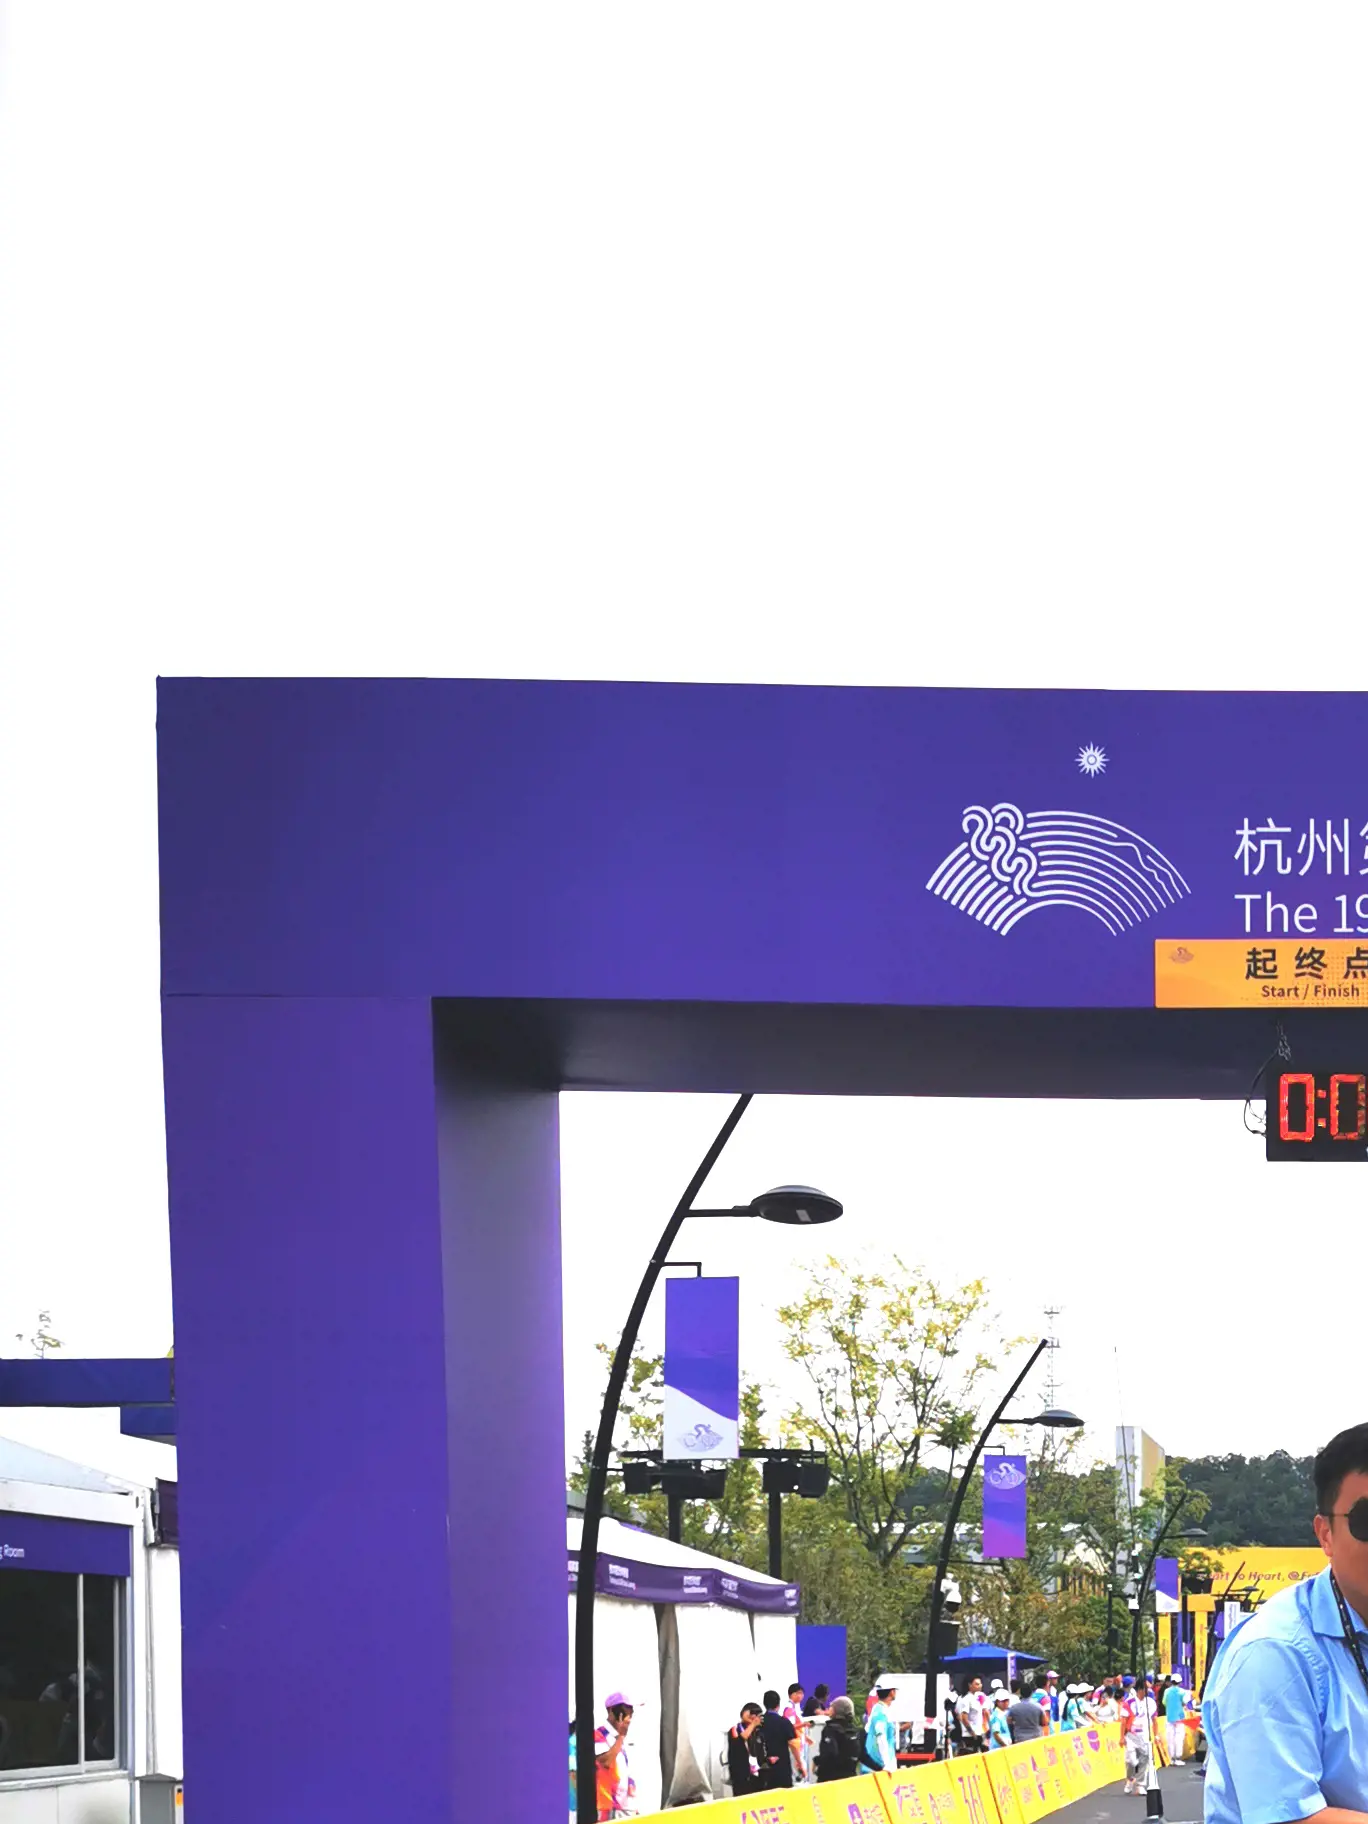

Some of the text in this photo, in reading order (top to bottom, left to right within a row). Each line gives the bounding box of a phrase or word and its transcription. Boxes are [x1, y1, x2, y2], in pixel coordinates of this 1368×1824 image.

[1235, 891, 1318, 934] The
[1261, 983, 1299, 998] Start
[1314, 983, 1360, 998] Finish
